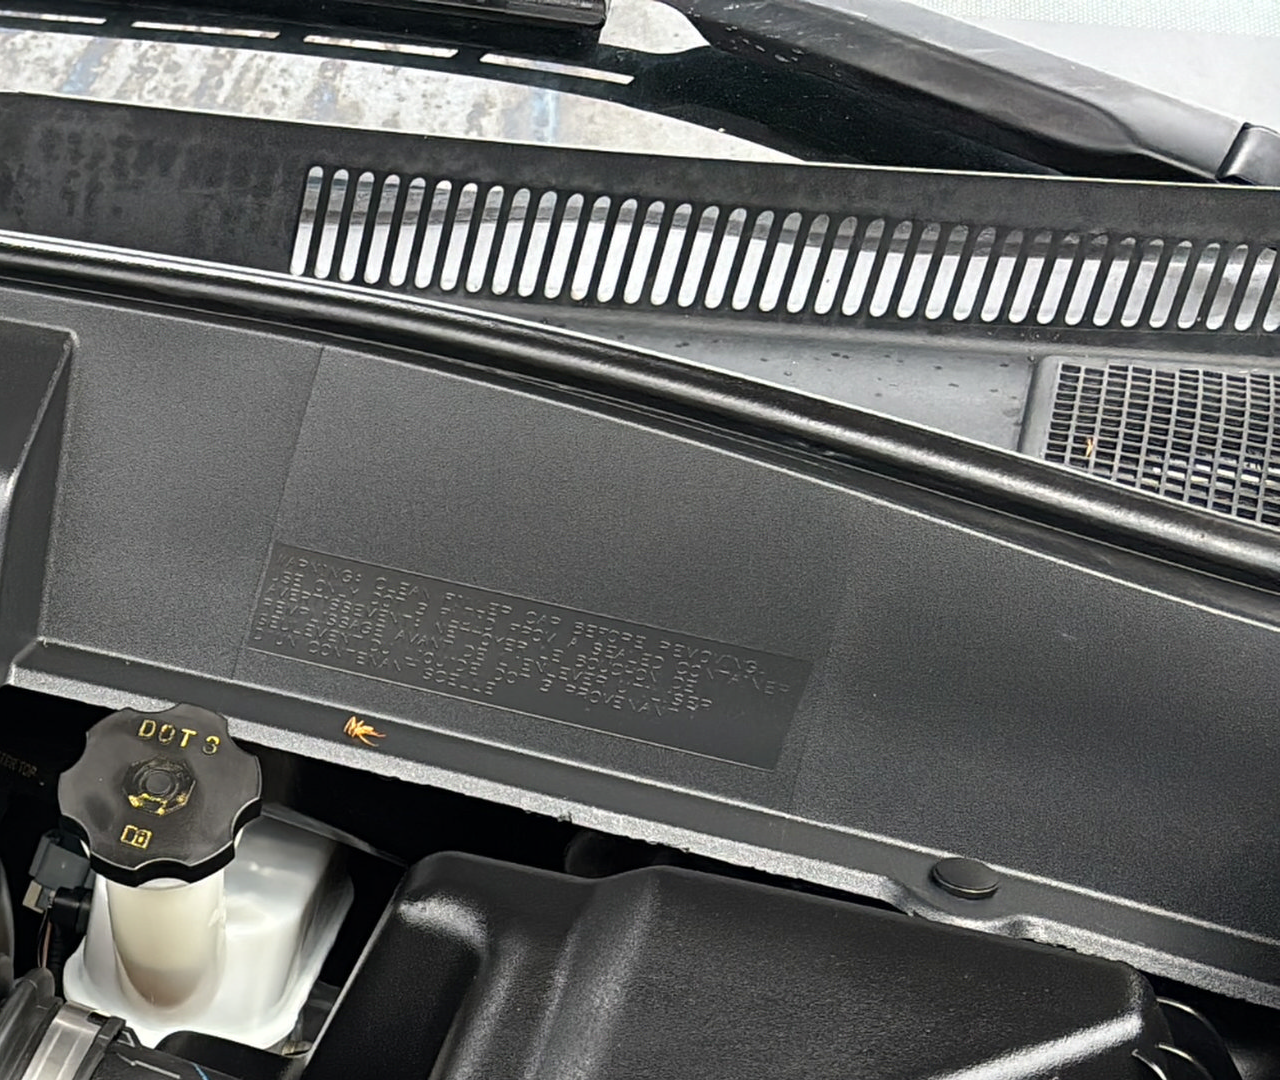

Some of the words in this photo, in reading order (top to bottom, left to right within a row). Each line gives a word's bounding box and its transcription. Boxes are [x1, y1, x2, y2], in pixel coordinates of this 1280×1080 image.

[138, 719, 198, 749] DOT
[201, 735, 222, 756] 3
[18, 758, 41, 780] TOP
